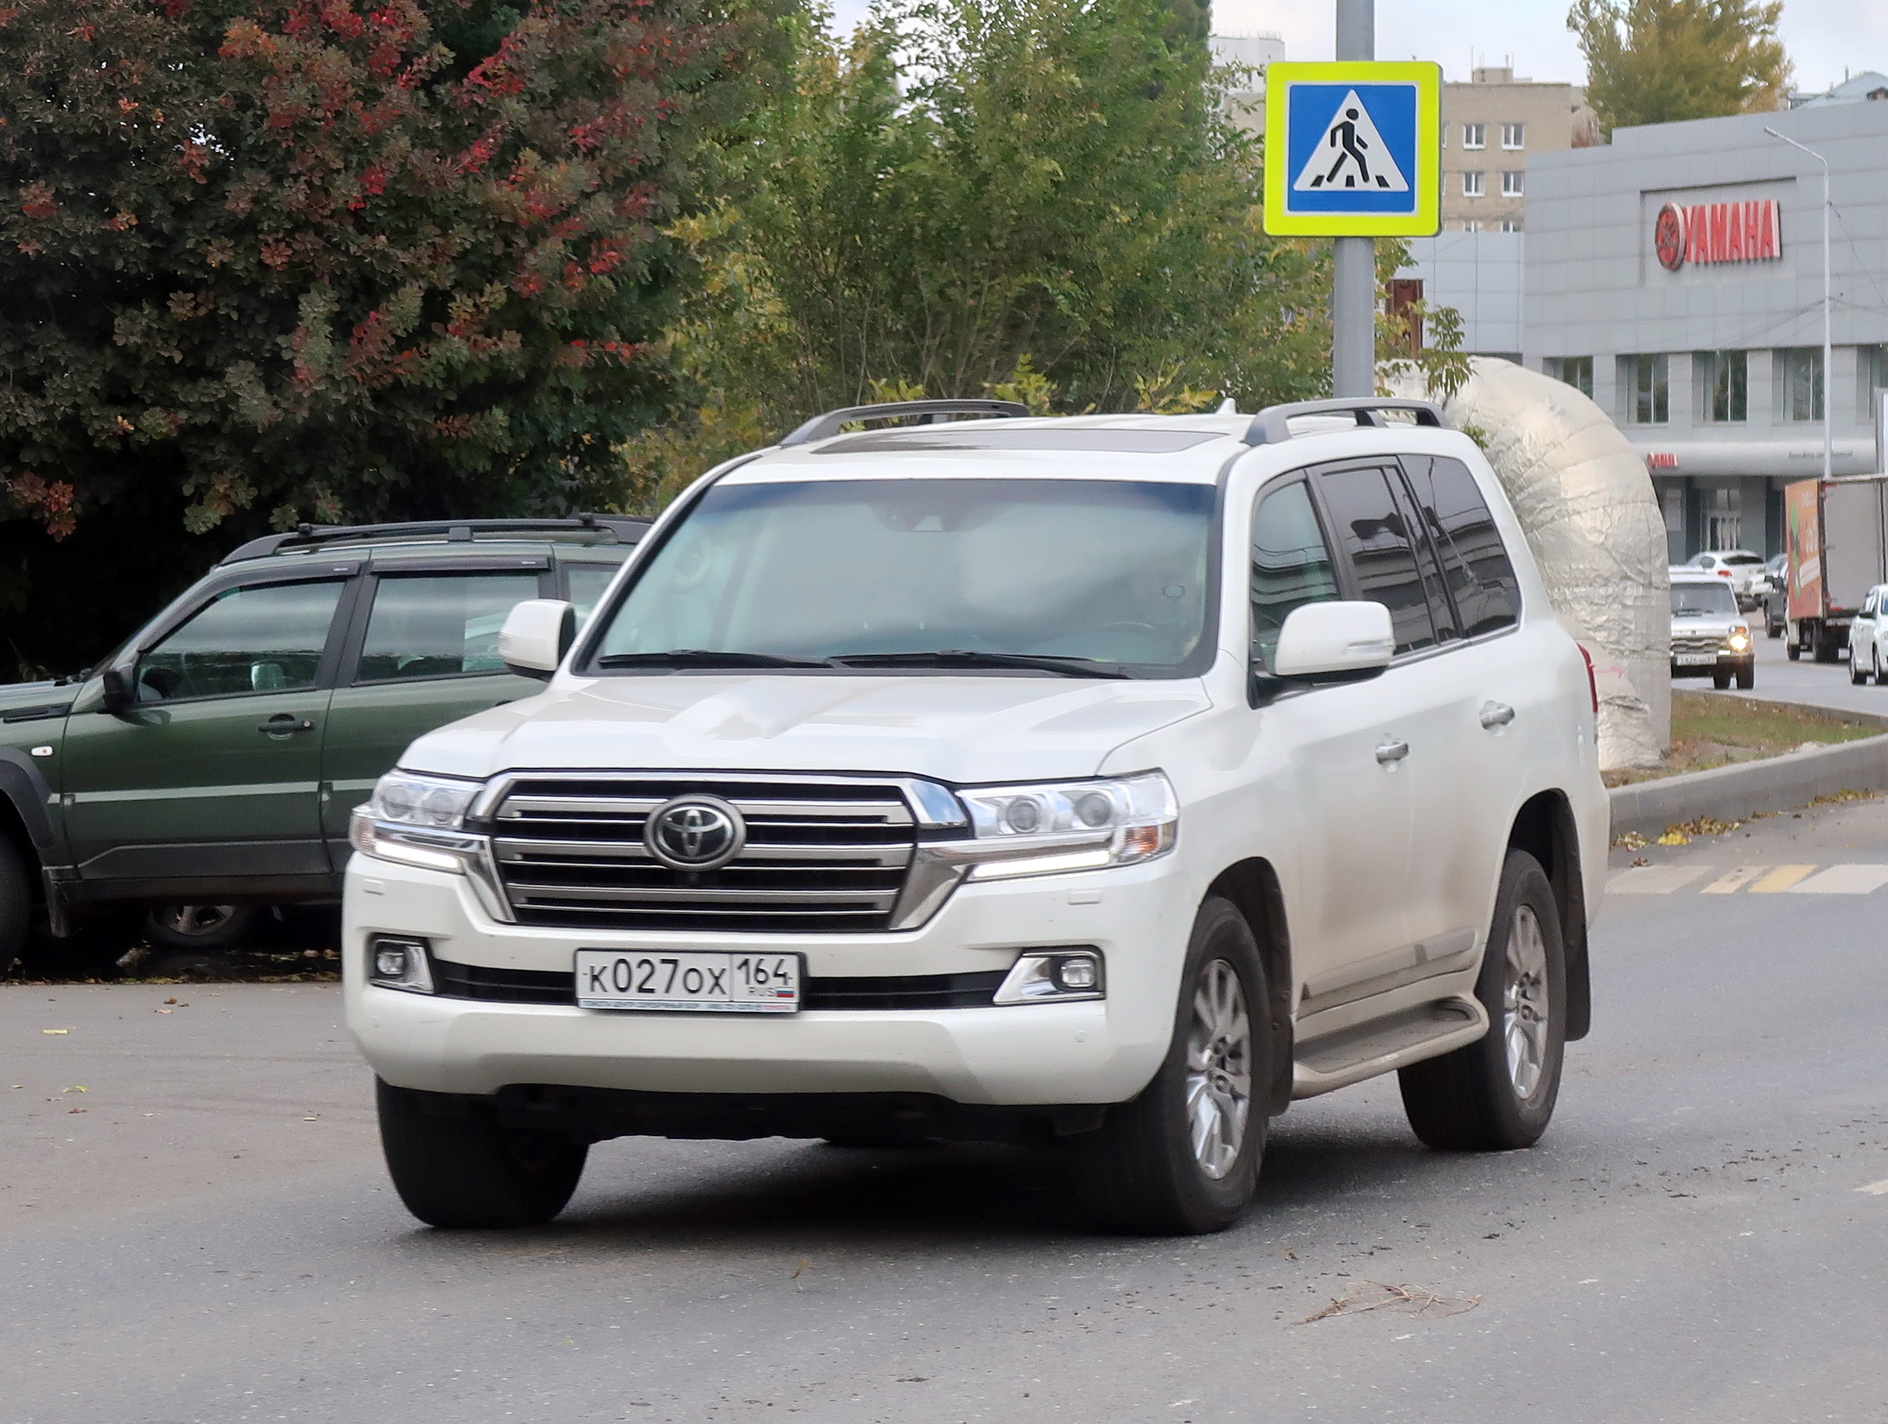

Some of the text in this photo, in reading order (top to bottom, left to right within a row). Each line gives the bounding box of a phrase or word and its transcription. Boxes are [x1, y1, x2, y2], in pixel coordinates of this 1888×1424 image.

[1682, 198, 1778, 263] YAMAHA
[737, 957, 790, 986] 164
[749, 986, 775, 997] RUS
